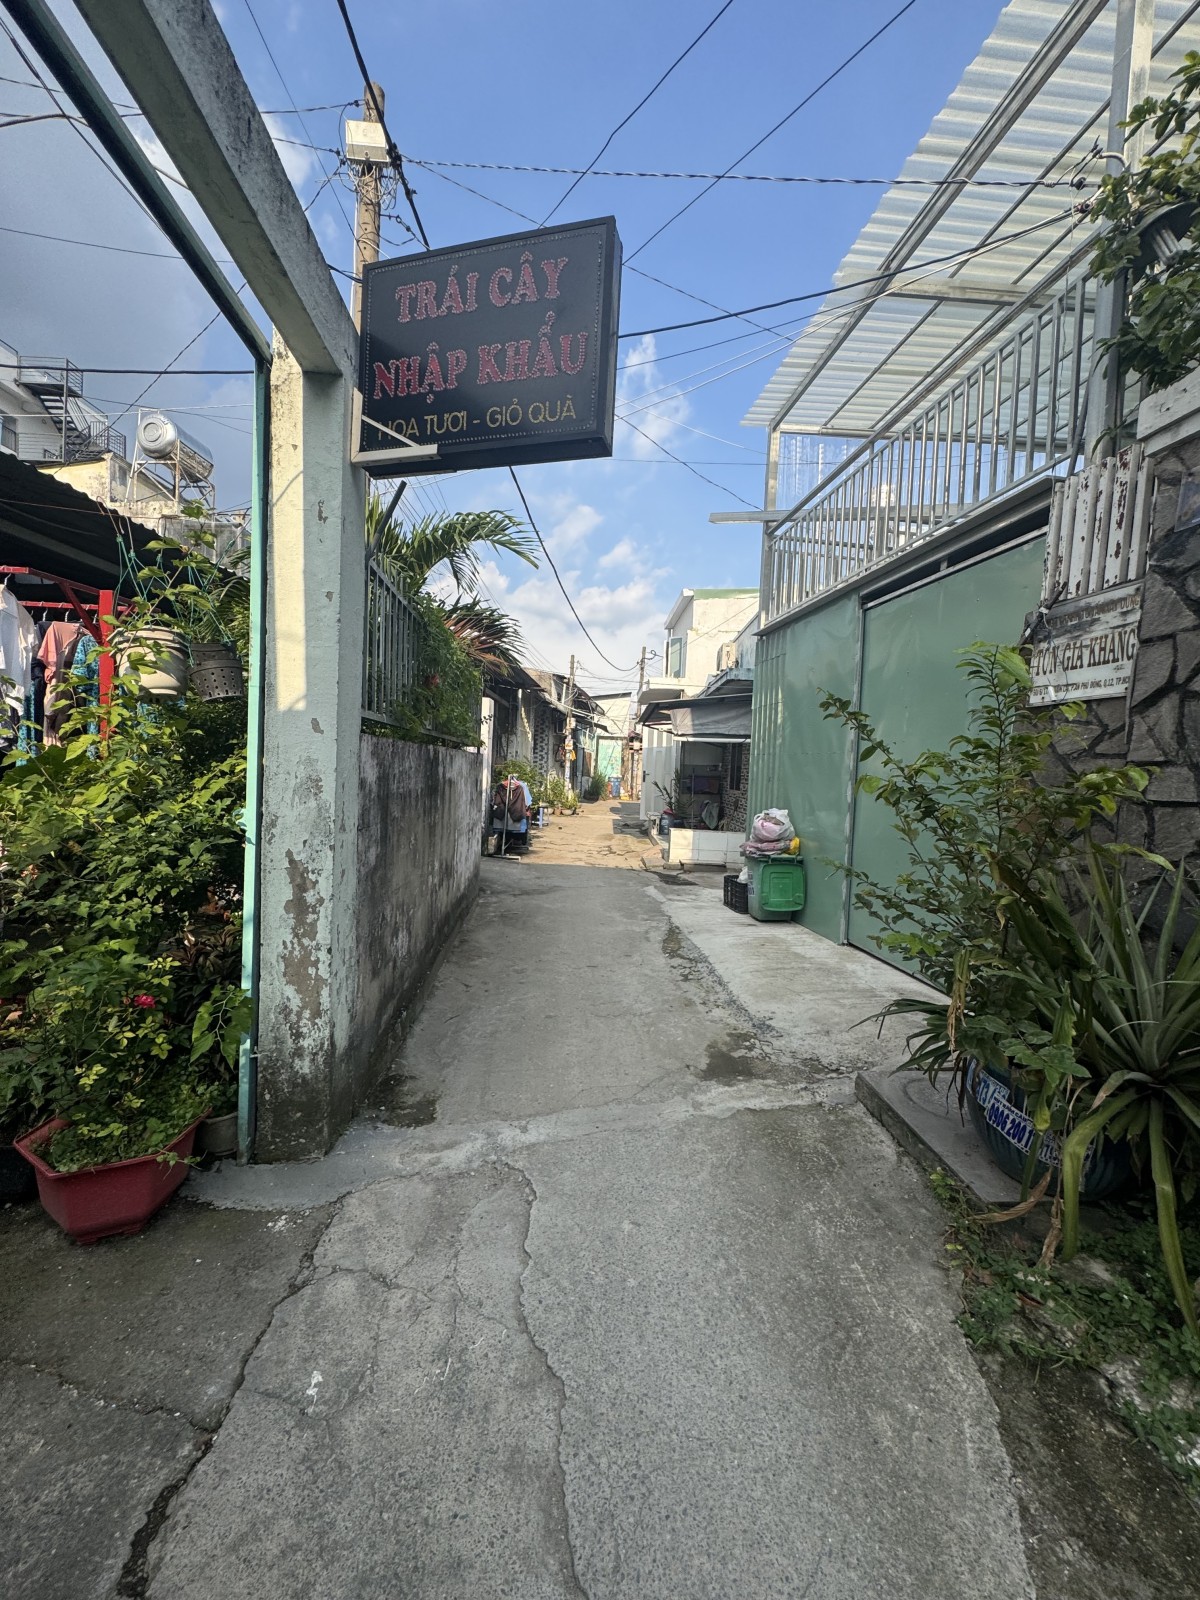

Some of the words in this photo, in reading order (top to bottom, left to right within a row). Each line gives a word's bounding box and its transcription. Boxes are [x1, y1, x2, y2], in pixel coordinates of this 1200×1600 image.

[395, 265, 480, 323] TRÁI
[489, 251, 568, 307] CÂY
[373, 341, 467, 403] NHẬP
[476, 311, 588, 385] KHẨU
[378, 417, 419, 440] HOA
[424, 410, 467, 435] TƯƠI
[486, 398, 522, 428] GIỎ
[1062, 641, 1084, 671] GIA
[1087, 628, 1136, 668] KHANG
[1005, 1117, 1027, 1144] 200
